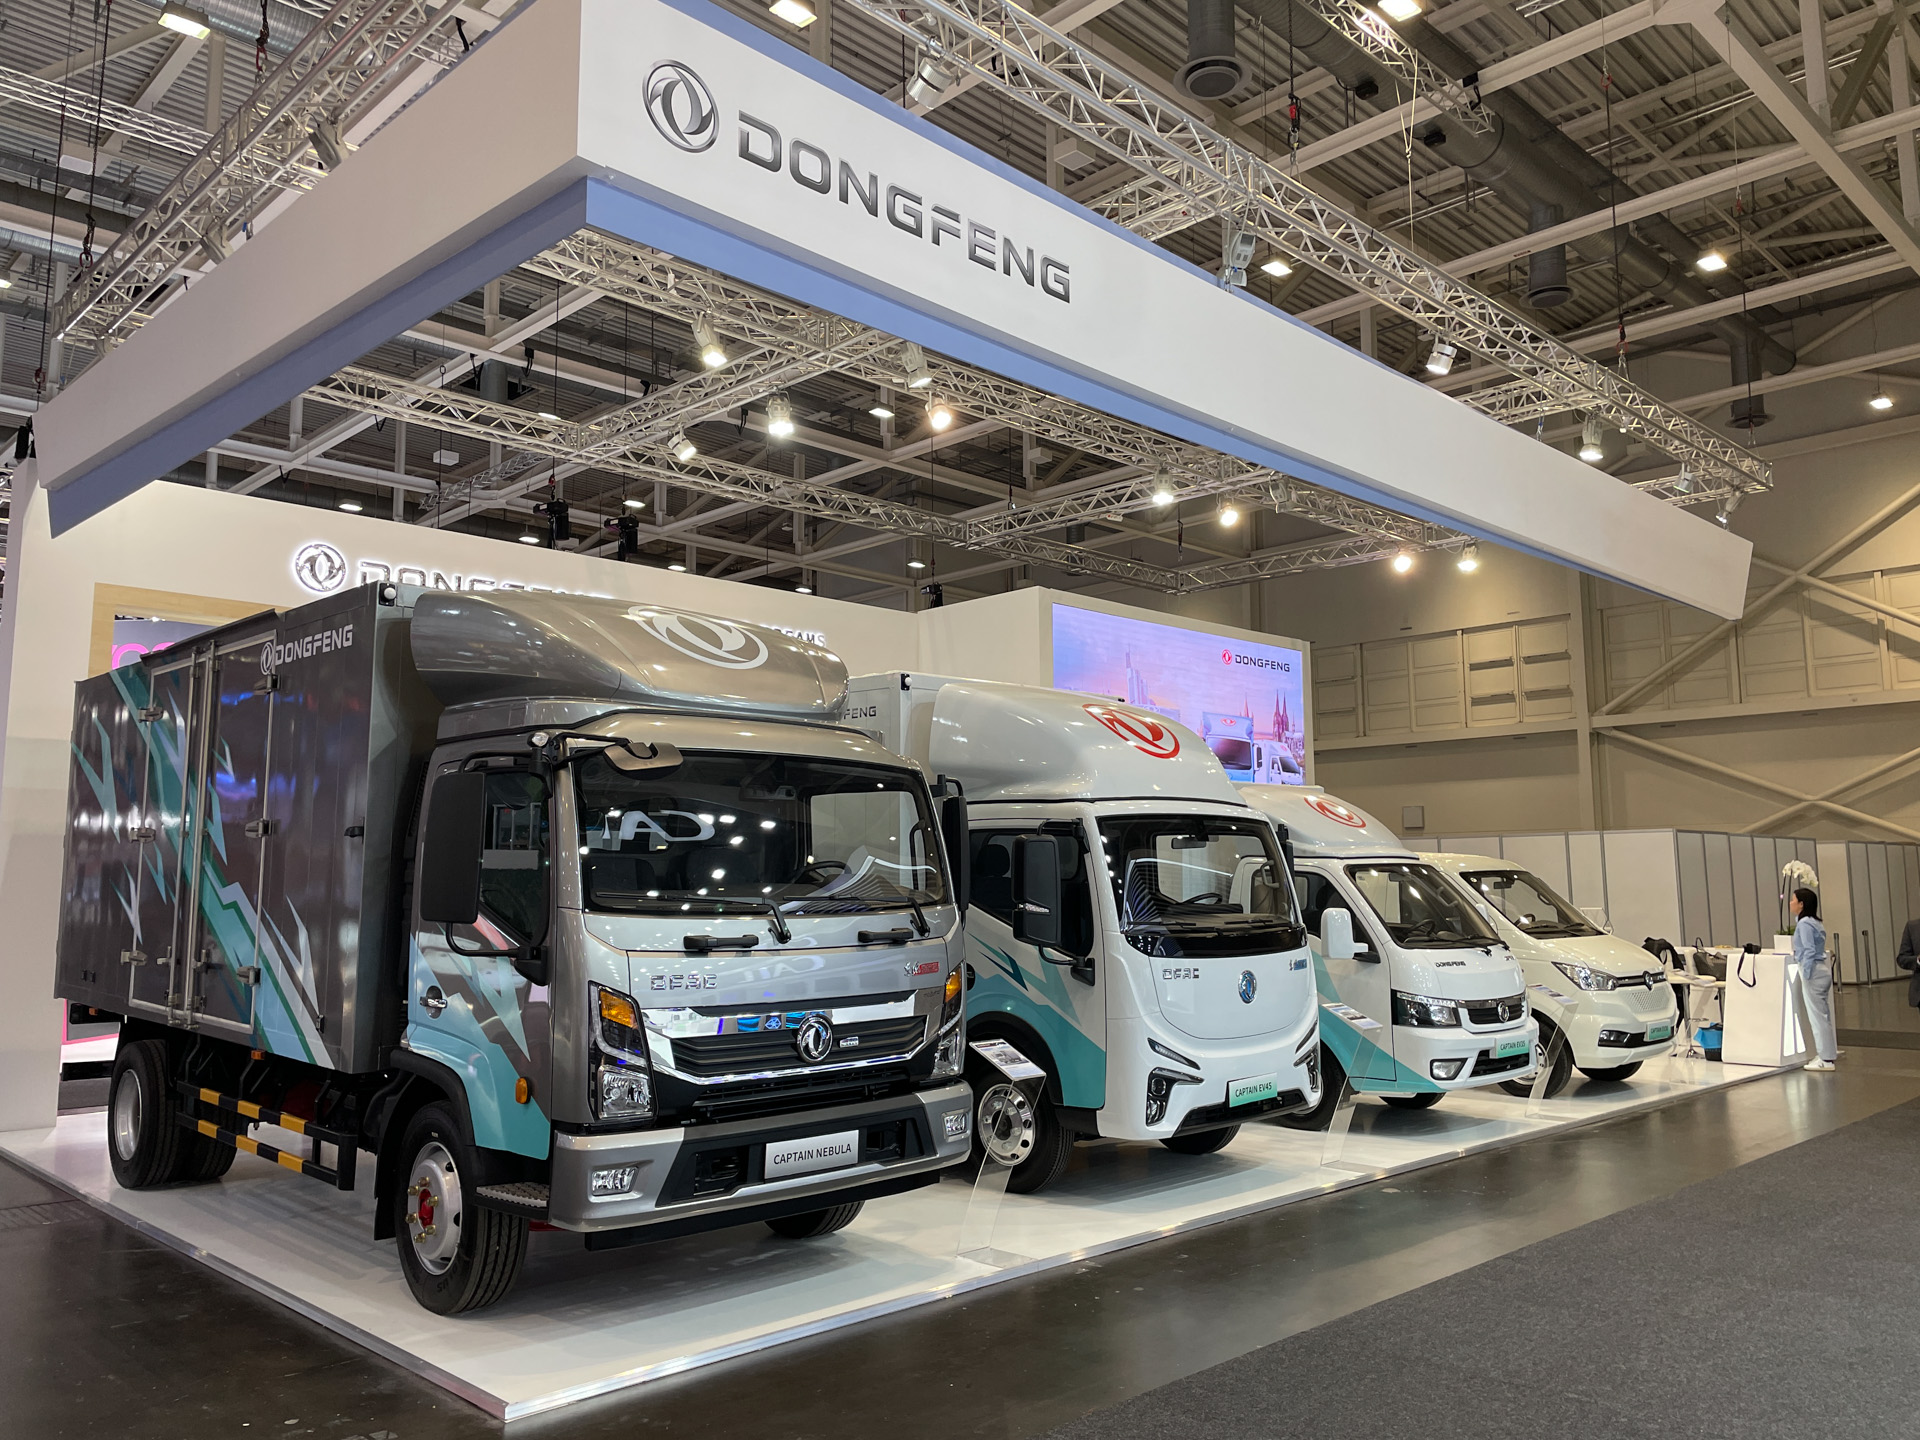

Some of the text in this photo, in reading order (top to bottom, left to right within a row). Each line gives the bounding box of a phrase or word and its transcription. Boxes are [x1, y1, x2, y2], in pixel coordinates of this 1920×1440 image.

[738, 110, 1071, 304] DONGFENG
[275, 624, 354, 666] DONGFENG
[1235, 654, 1290, 672] DONGFENG
[1235, 1081, 1272, 1098] CAPTAIN EV45
[773, 1143, 852, 1165] CAPTAIN NEBULA
